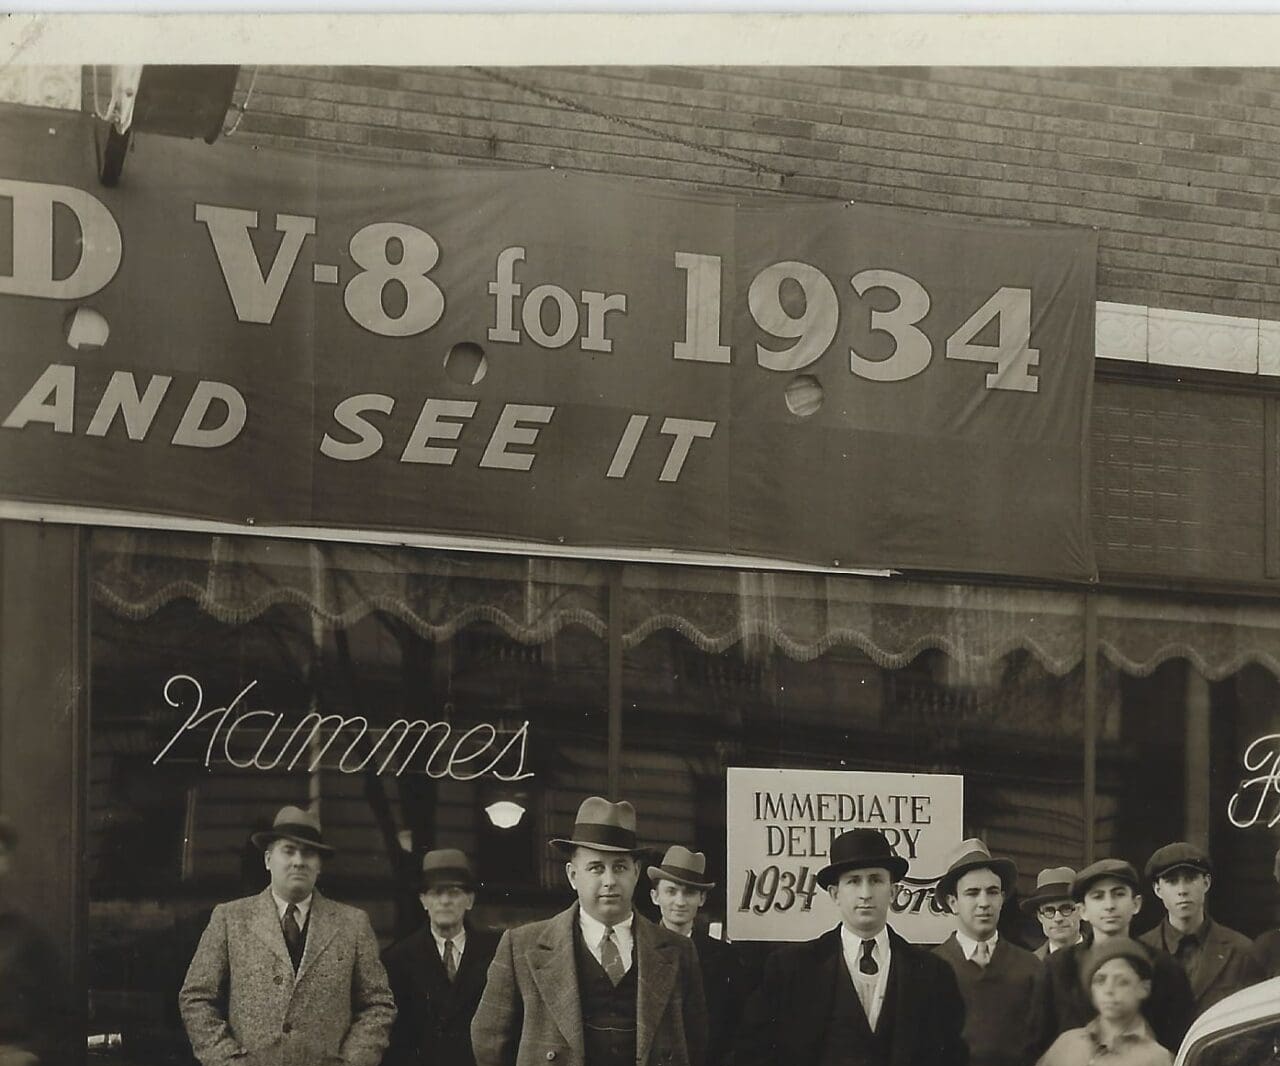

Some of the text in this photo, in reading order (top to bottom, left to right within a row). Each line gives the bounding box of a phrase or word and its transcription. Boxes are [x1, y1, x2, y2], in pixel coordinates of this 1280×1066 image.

[195, 203, 444, 337] V-8
[488, 246, 627, 352] for
[673, 251, 1040, 393] 1934
[2, 363, 717, 482] AND SEE IT
[152, 674, 535, 781] Hammes
[754, 791, 932, 824] IMMEDIATE
[738, 865, 818, 914] 1934
